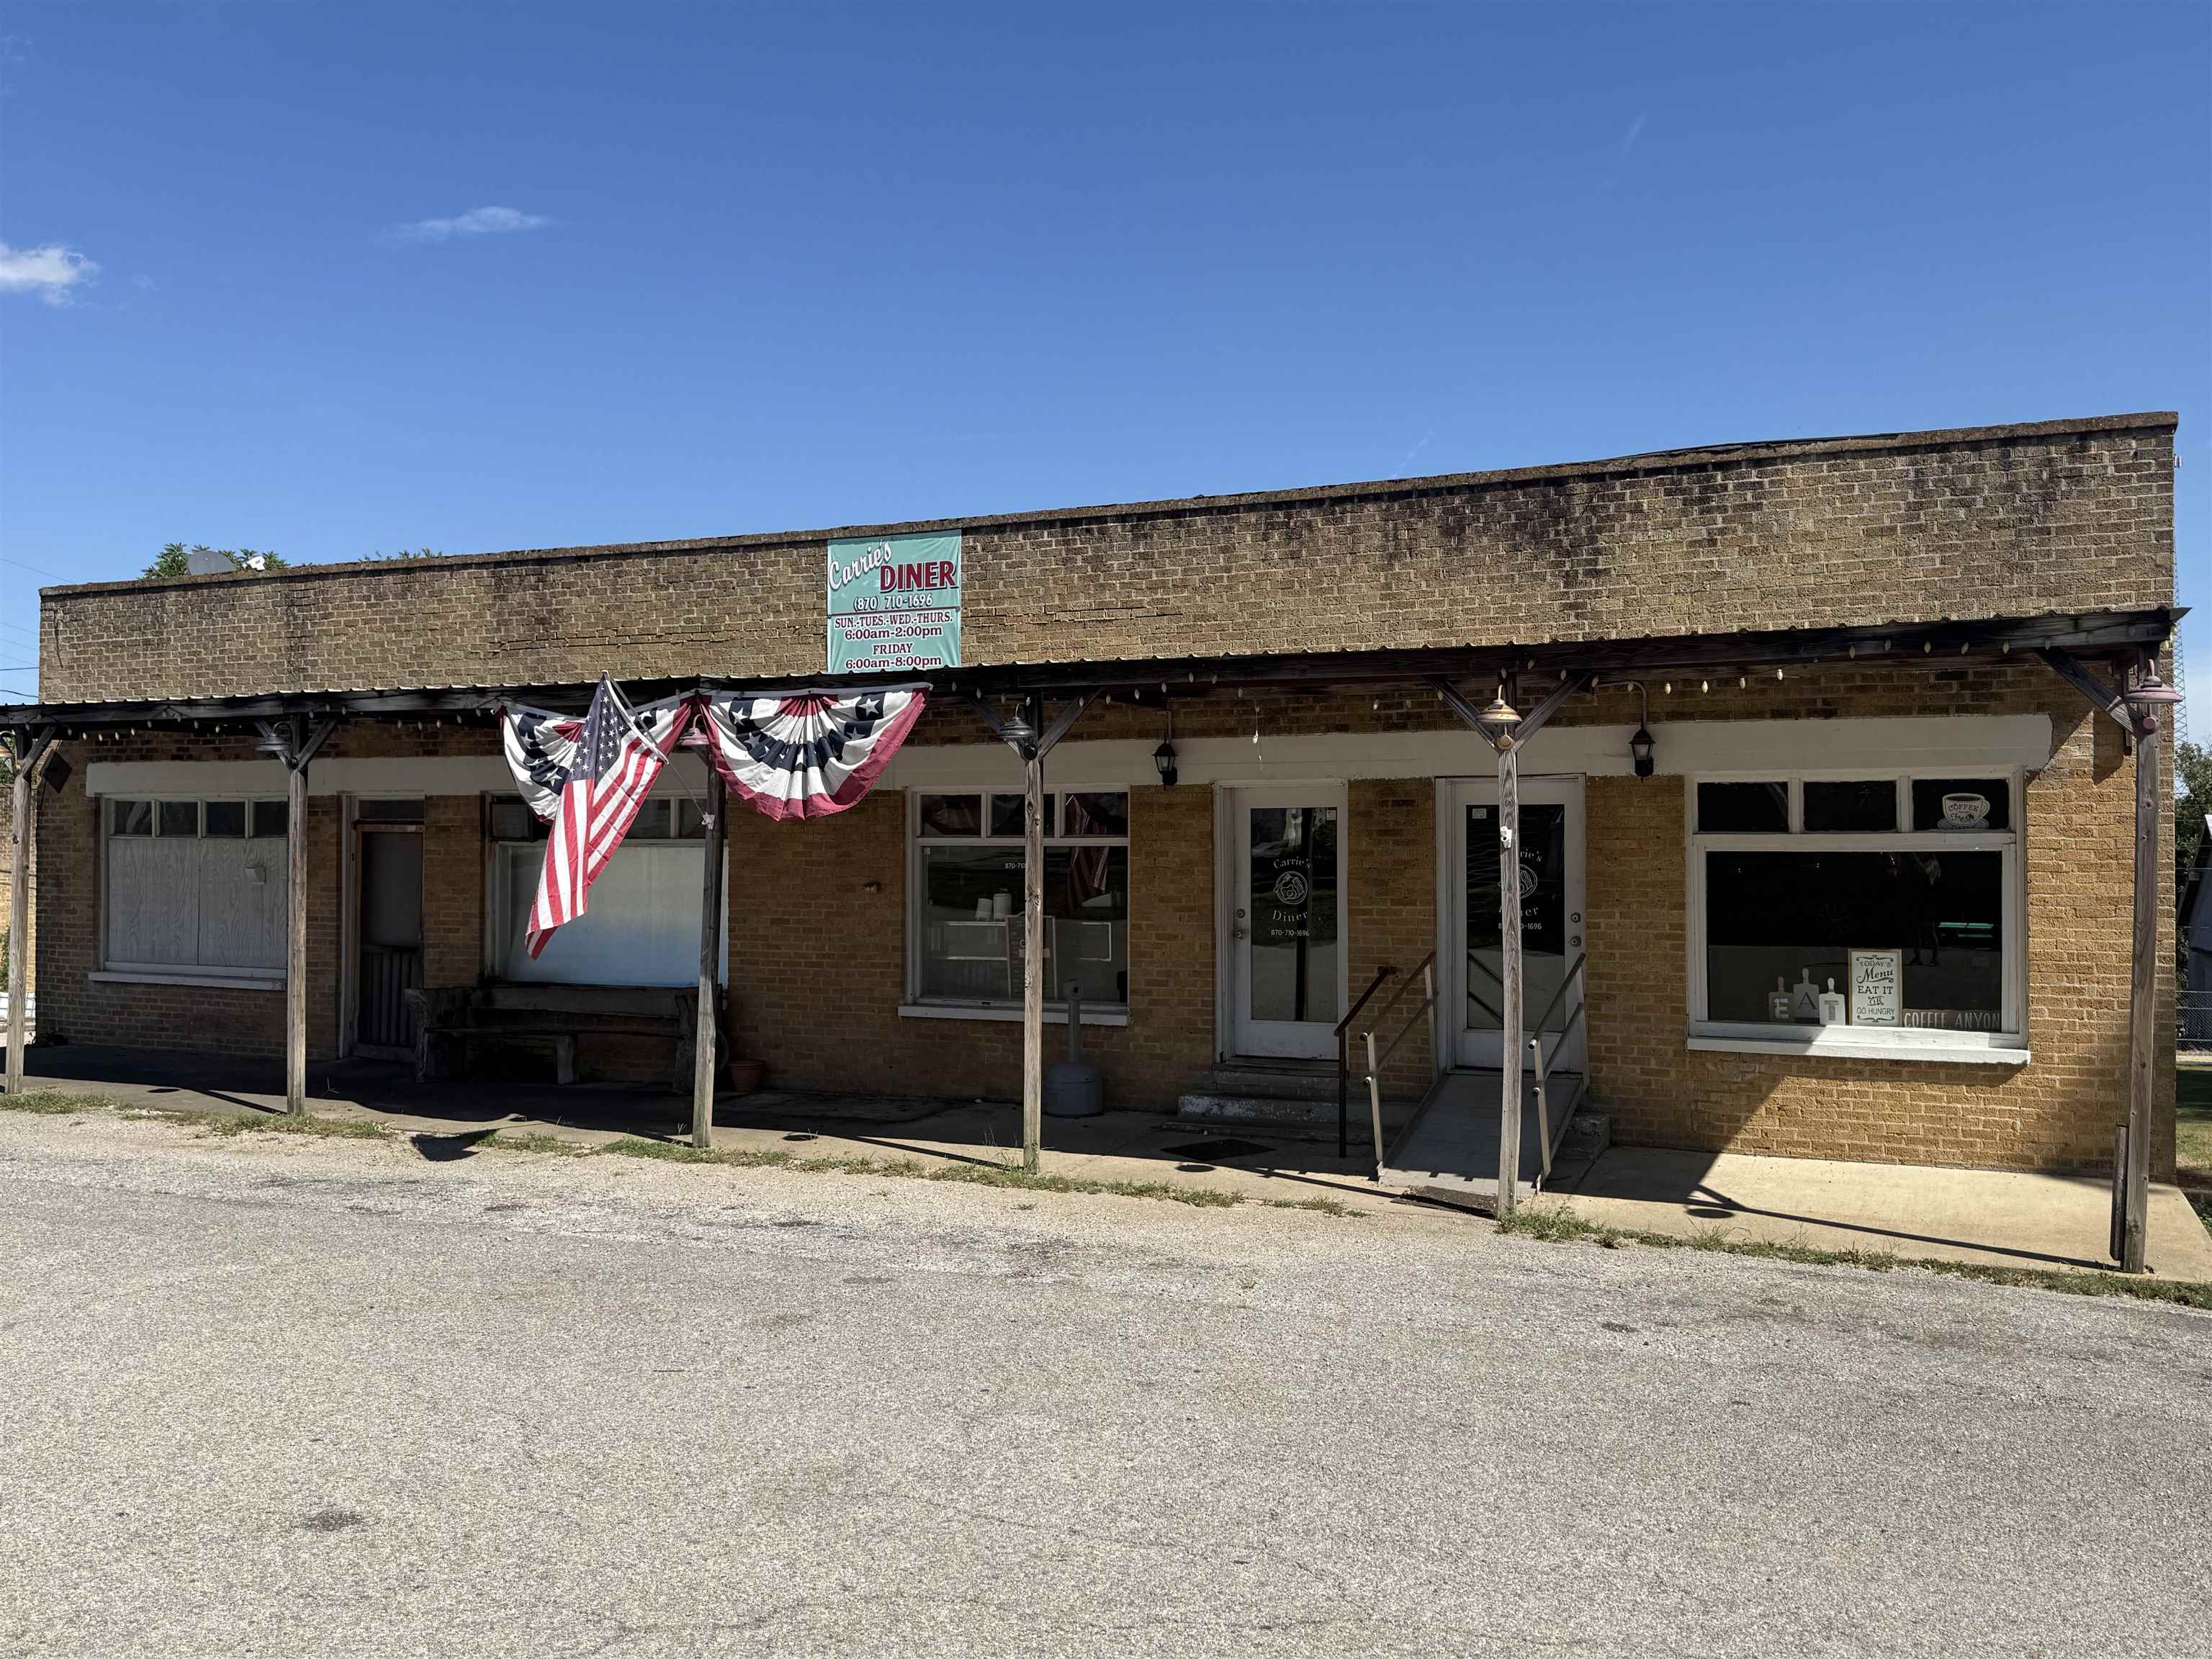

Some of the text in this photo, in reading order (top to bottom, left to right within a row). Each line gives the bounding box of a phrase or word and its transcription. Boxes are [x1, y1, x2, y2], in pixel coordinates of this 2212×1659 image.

[829, 539, 892, 590] Carrie's
[880, 560, 958, 593] DINER
[854, 593, 932, 612] (870) 710-1696
[845, 626, 943, 640] 6:00am-2:00pm
[873, 643, 914, 655] FRIDAY
[845, 656, 942, 670] 6:00am-8:00pm
[1948, 803, 1979, 812] COFFEE
[1273, 855, 1313, 869] Carrie's
[1520, 848, 1542, 862] rie's
[1272, 909, 1308, 922] Diner
[1856, 965, 1894, 984] Menu
[1858, 986, 1894, 994] EAT IT
[1955, 1012, 2000, 1029] ANYON
